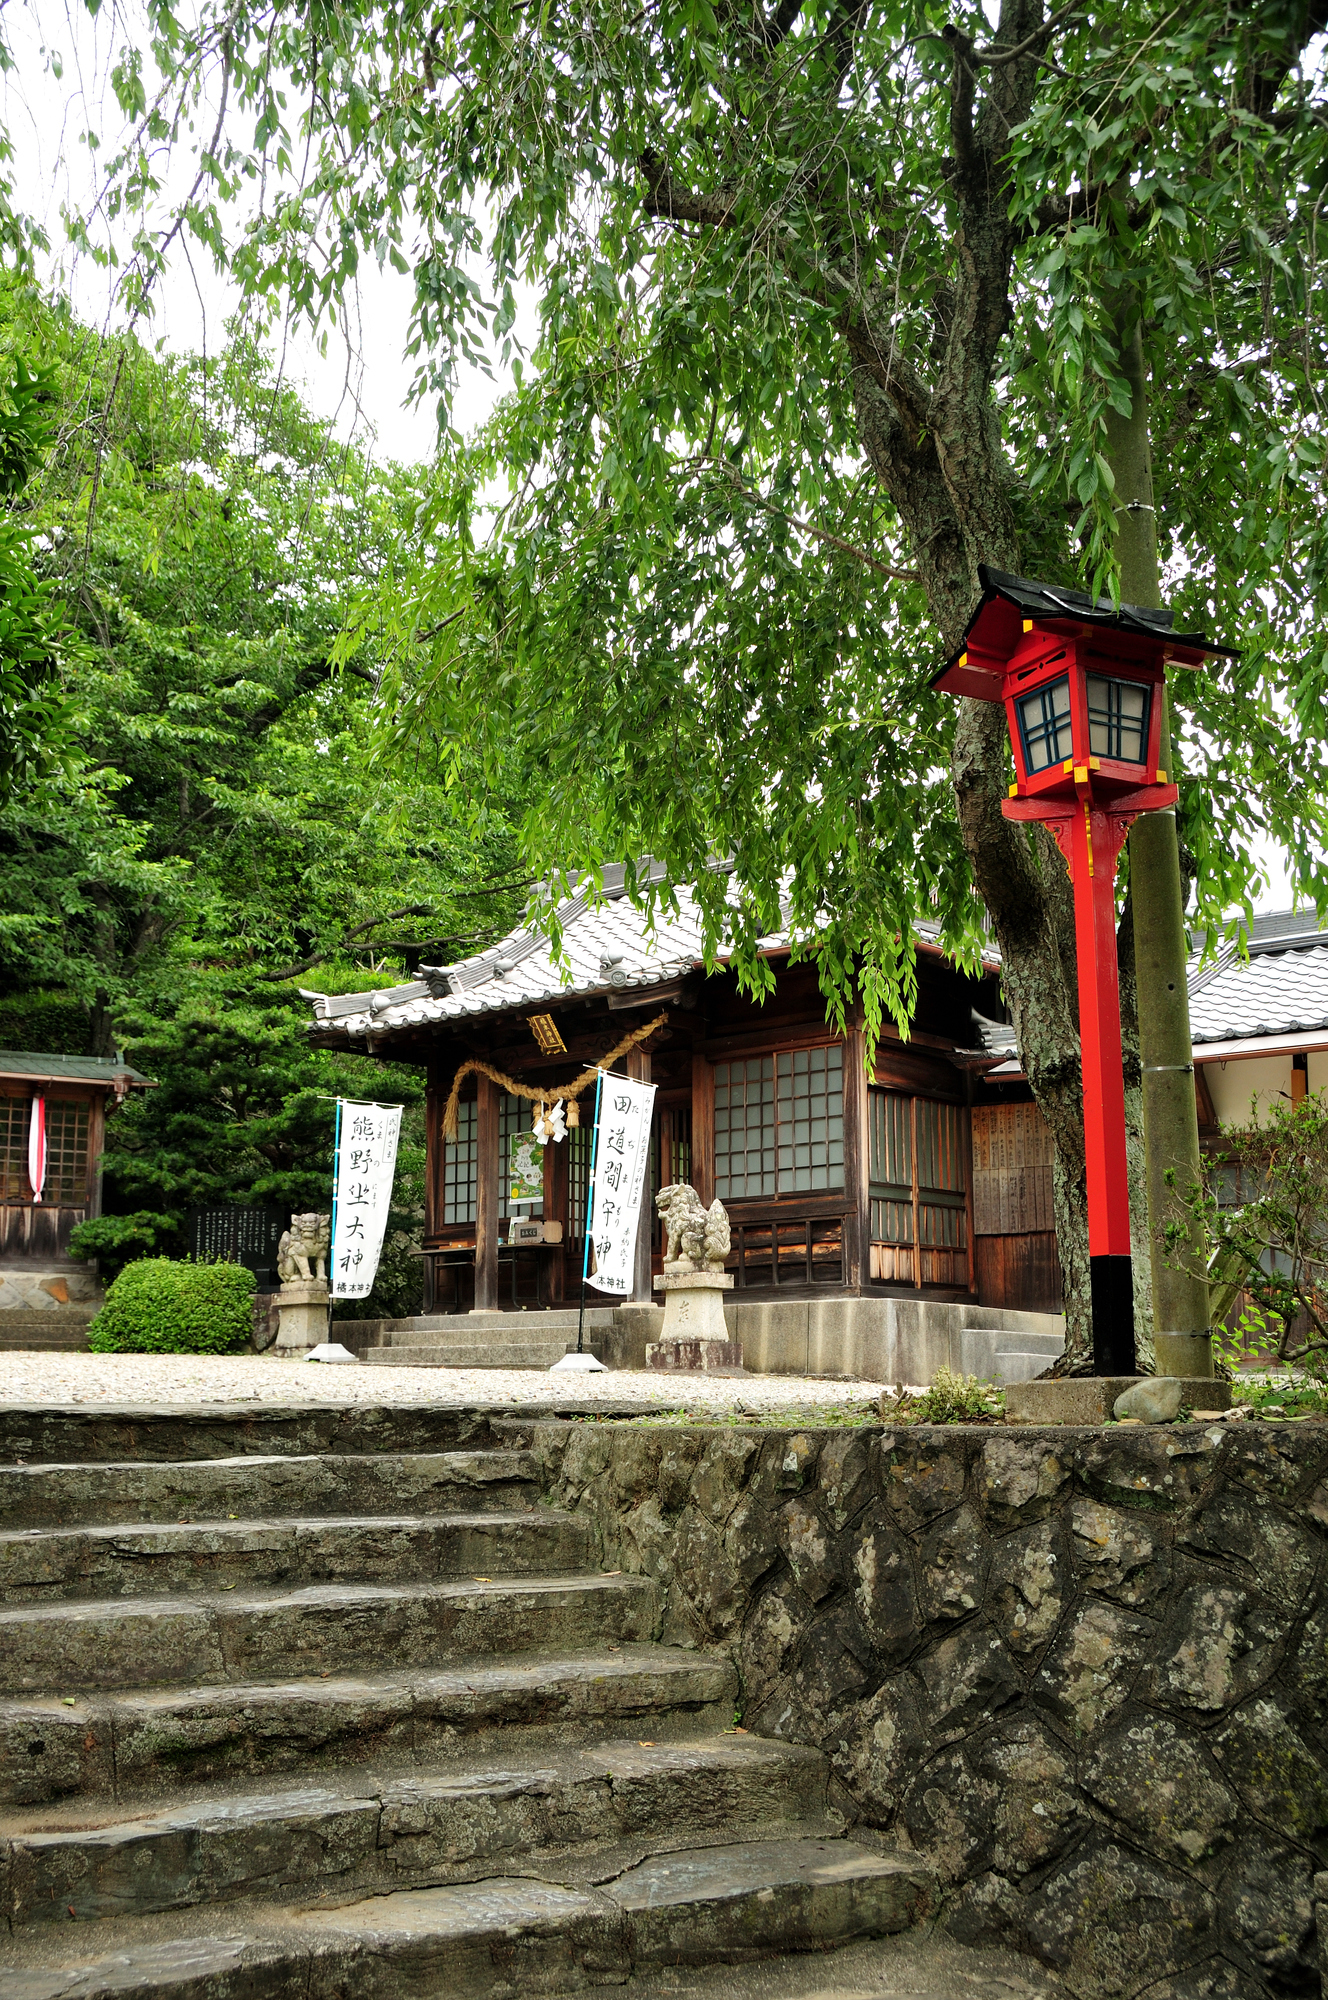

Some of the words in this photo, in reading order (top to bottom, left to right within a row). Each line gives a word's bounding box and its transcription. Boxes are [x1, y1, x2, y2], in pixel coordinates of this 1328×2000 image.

[338, 1115, 375, 1275] 熊野坐大神
[597, 1274, 626, 1290] 本神社
